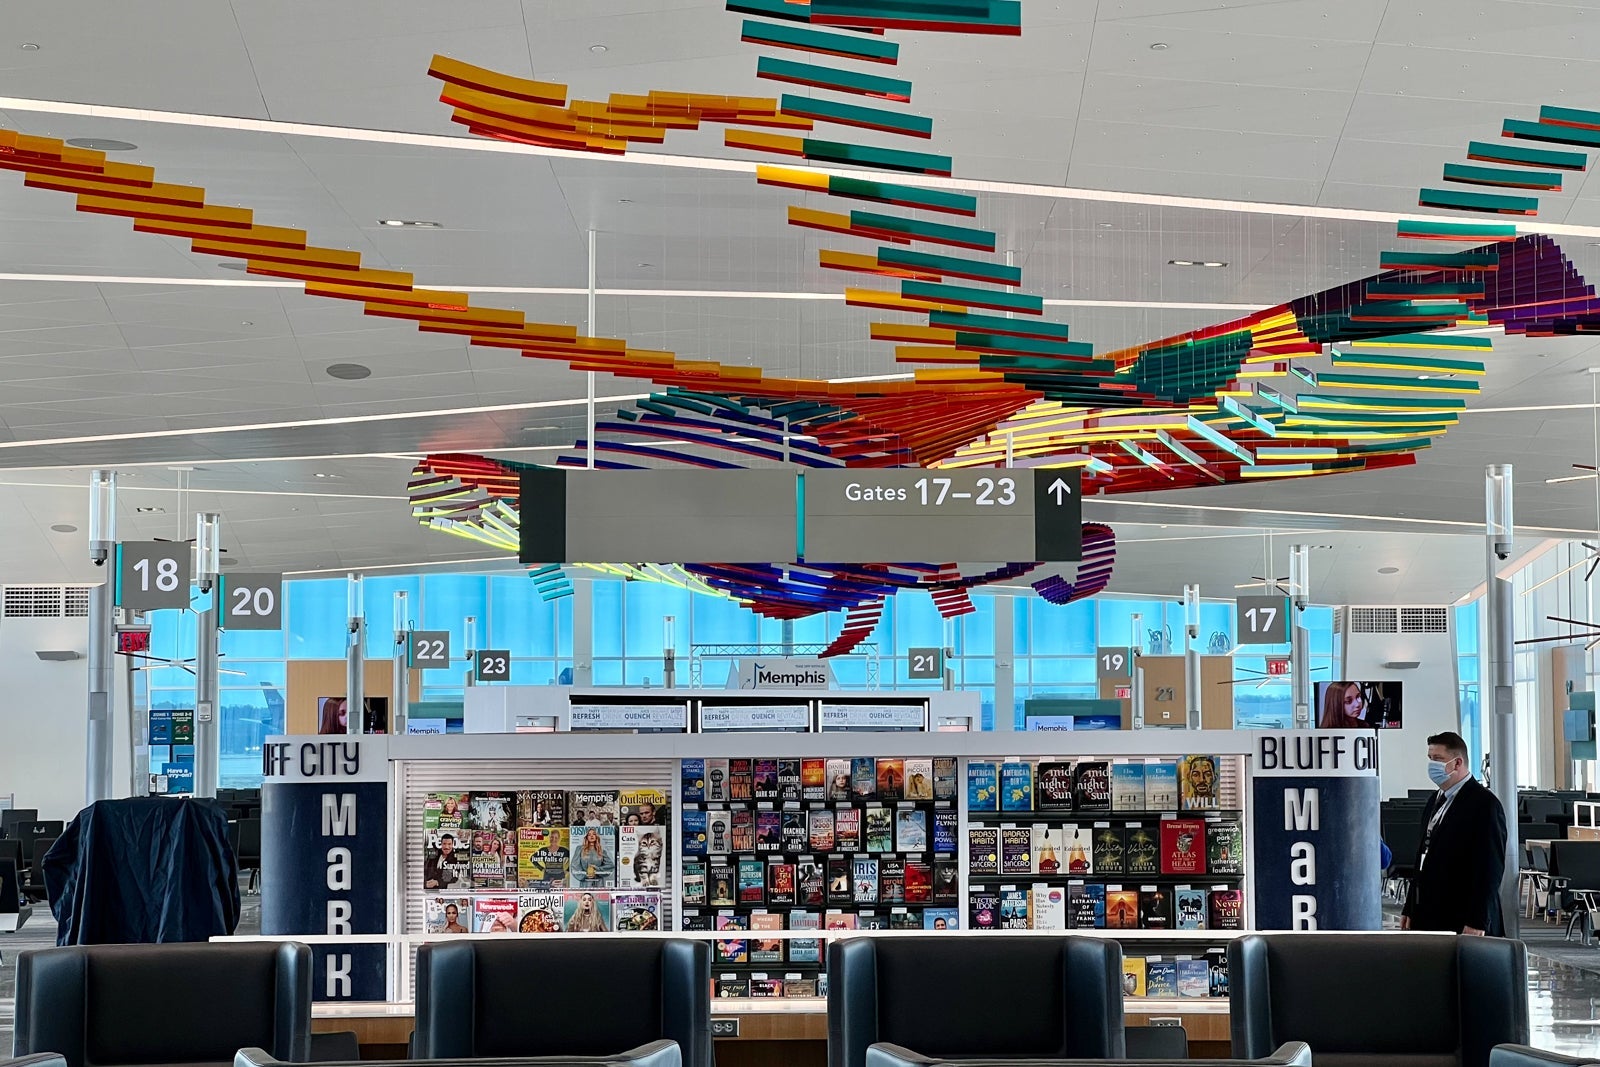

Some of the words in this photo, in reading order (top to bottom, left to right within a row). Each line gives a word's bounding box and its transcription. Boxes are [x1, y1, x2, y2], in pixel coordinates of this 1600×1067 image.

[845, 483, 907, 501] Gates
[133, 558, 179, 592] 18
[231, 587, 275, 616] 20
[1244, 607, 1277, 632] 17
[416, 640, 445, 660] 22
[482, 657, 506, 674] 23
[913, 655, 934, 672] 21
[1102, 654, 1124, 671] 19
[758, 671, 826, 687] Memphis
[1155, 687, 1175, 702] 21
[1260, 735, 1346, 770] BLUFF
[300, 742, 360, 777] CITY
[1003, 769, 1030, 777] AMERICAN
[1050, 766, 1072, 777] mid
[1088, 766, 1109, 777] mid
[975, 778, 988, 786] DIRT
[1010, 778, 1024, 786] DIRT
[1039, 778, 1066, 792] night
[1077, 779, 1104, 793] night
[730, 784, 752, 798] WIRE
[1052, 792, 1072, 800] sun
[1090, 792, 1110, 800] sun
[575, 794, 614, 804] Memphis
[620, 794, 665, 805] Outlander
[1186, 797, 1219, 810] WILL
[836, 812, 858, 822] MICHAEL
[836, 822, 858, 832] CONNELLY
[1208, 827, 1240, 835] greenwich
[732, 836, 754, 850] WIRE
[1216, 834, 1231, 842] park
[1094, 843, 1124, 854] Verity
[1128, 843, 1157, 854] Verity
[443, 860, 470, 870] Survived
[854, 862, 876, 874] IRIS
[684, 885, 704, 896] LOST
[480, 903, 514, 911] Newsweek
[519, 896, 564, 910] EatingWell
[1002, 899, 1026, 908] PATTERSON
[1215, 899, 1242, 908] Never
[1182, 905, 1198, 913] The
[1220, 908, 1238, 917] Tell
[1178, 912, 1205, 921] Push
[1010, 918, 1027, 928] PARIS
